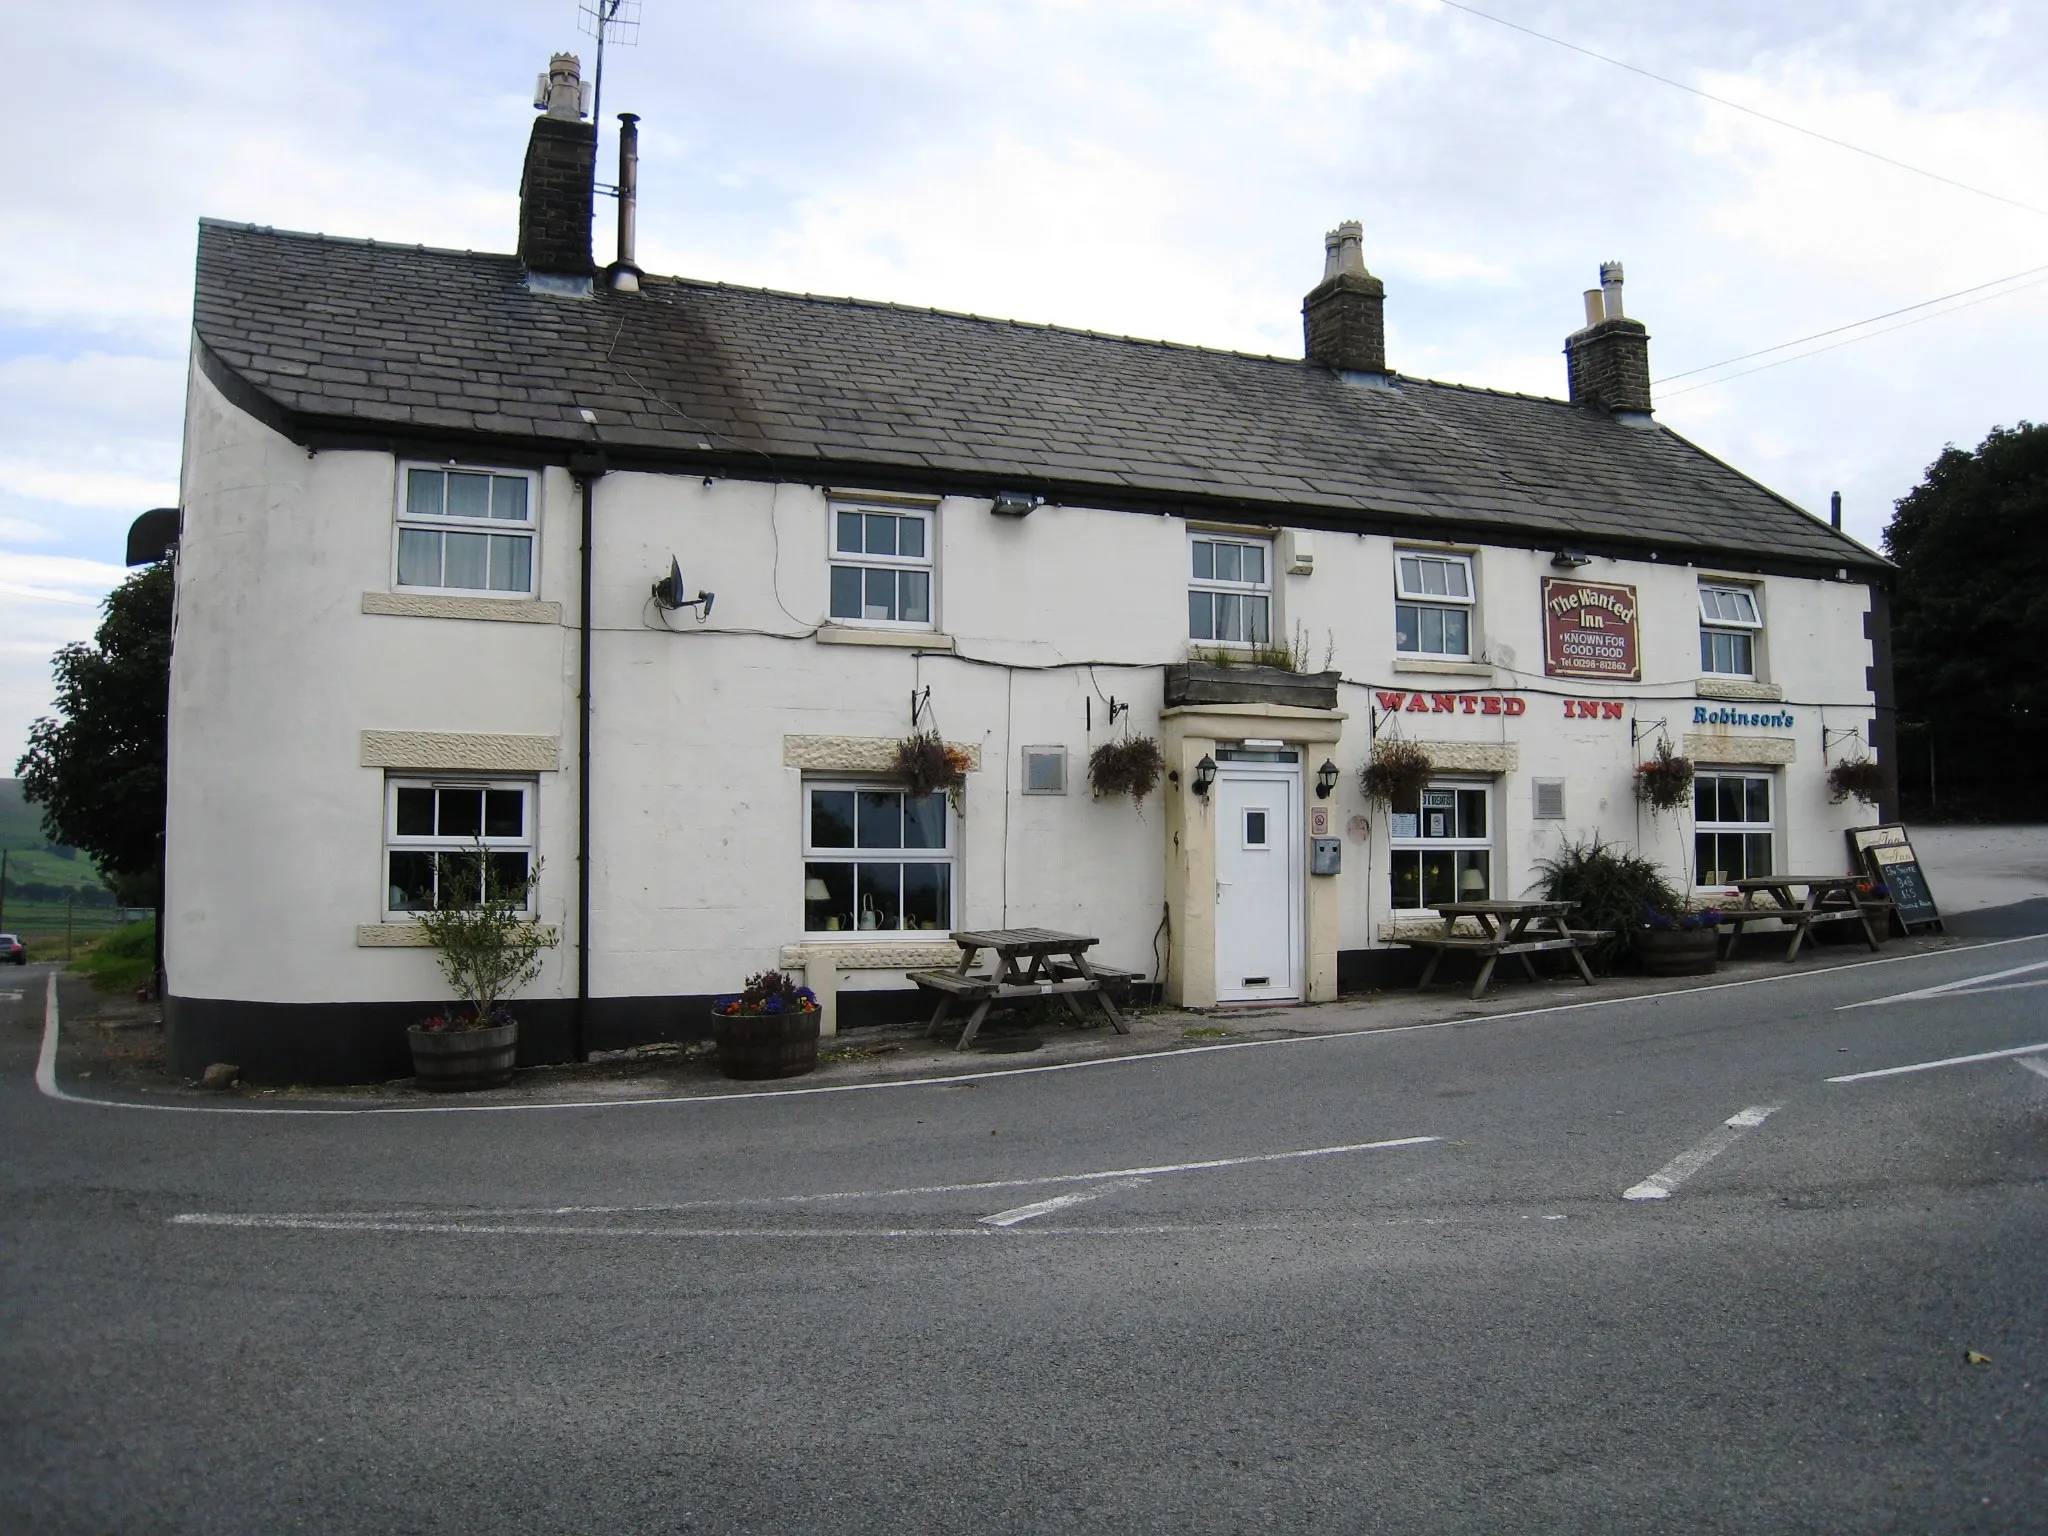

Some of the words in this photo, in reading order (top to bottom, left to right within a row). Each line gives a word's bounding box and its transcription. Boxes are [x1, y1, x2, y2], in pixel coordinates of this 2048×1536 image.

[1549, 593, 1578, 616] The
[1577, 588, 1634, 624] Wanted
[1579, 608, 1605, 628] Inn
[1562, 643, 1593, 655] GOOD
[1595, 646, 1624, 658] FOOD
[1605, 636, 1625, 647] FOR
[1375, 691, 1526, 716] WANTED
[1563, 700, 1624, 720] INN
[1692, 705, 1795, 728] Robinson's
